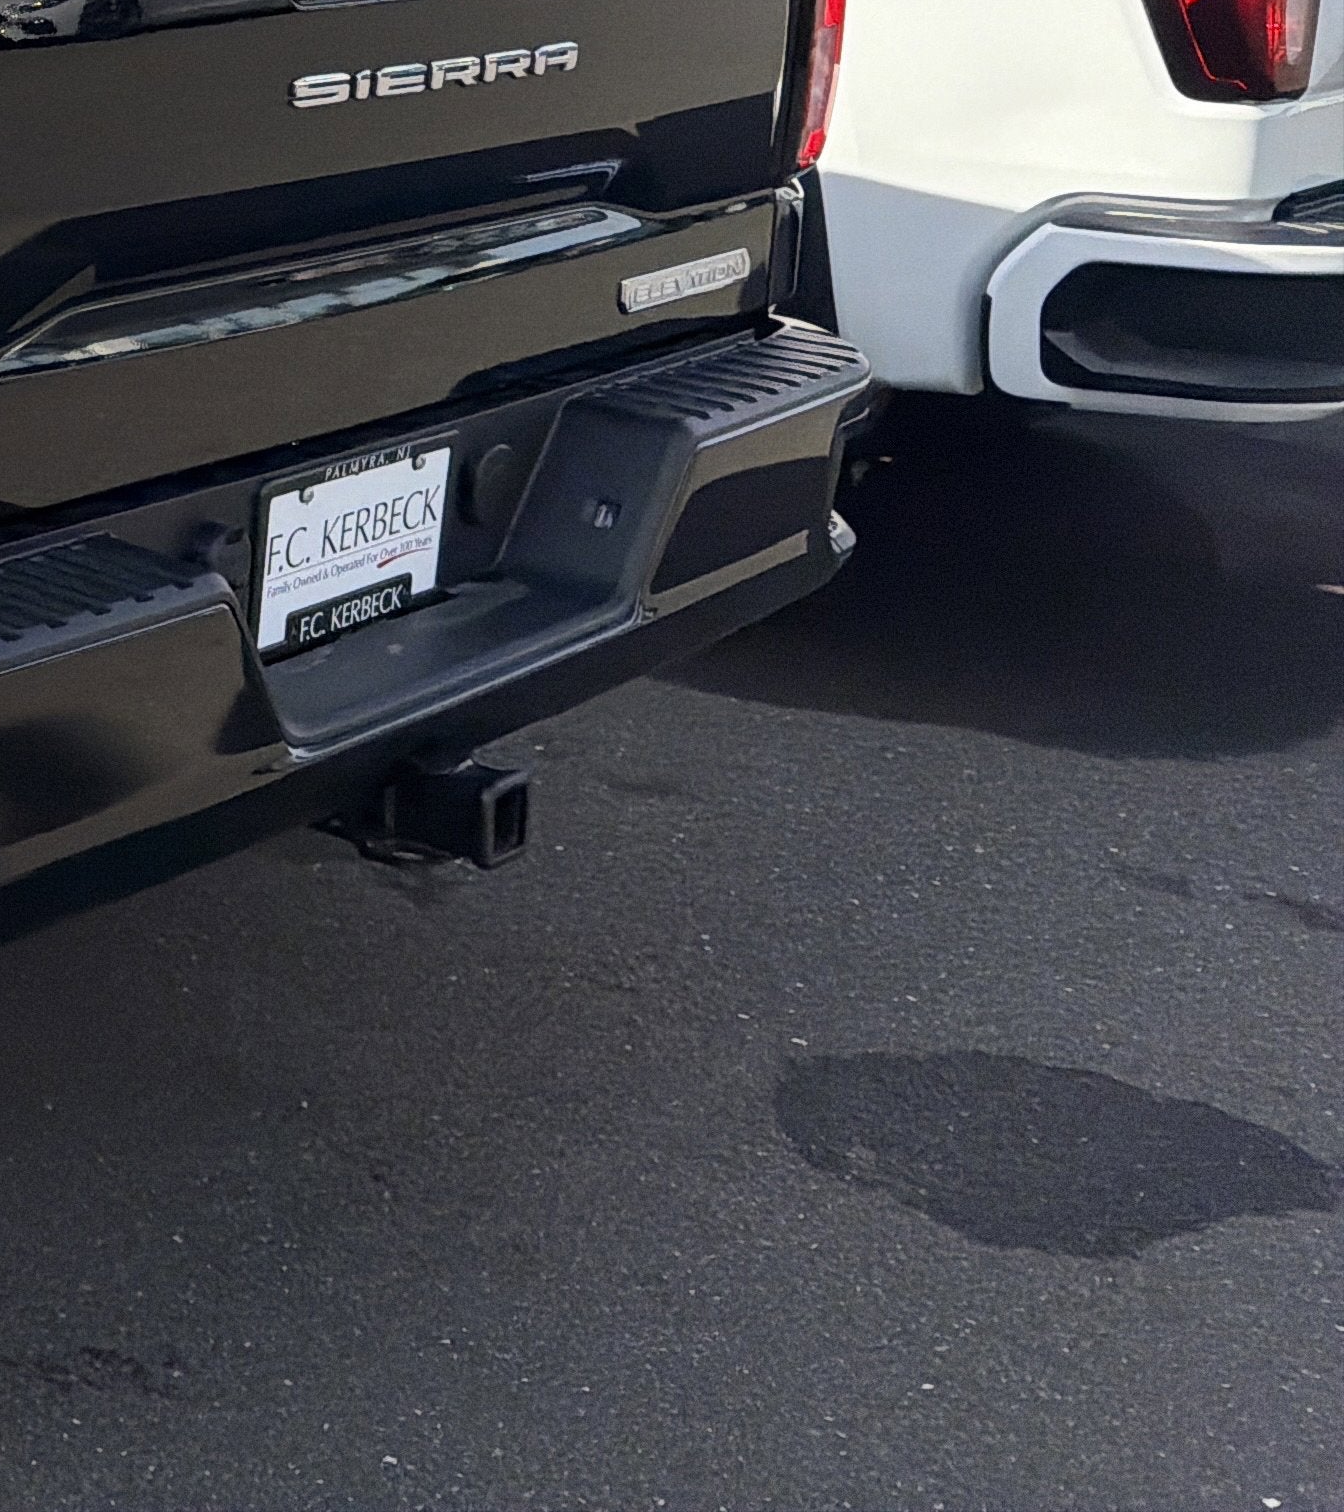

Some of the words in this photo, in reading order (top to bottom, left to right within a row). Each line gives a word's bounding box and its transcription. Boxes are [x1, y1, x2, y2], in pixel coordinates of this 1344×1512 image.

[288, 41, 579, 108] SIERRA
[266, 526, 311, 576] F.C.
[321, 484, 441, 558] KERBECK
[299, 610, 327, 643] F.C.
[330, 583, 404, 632] KERBECK
